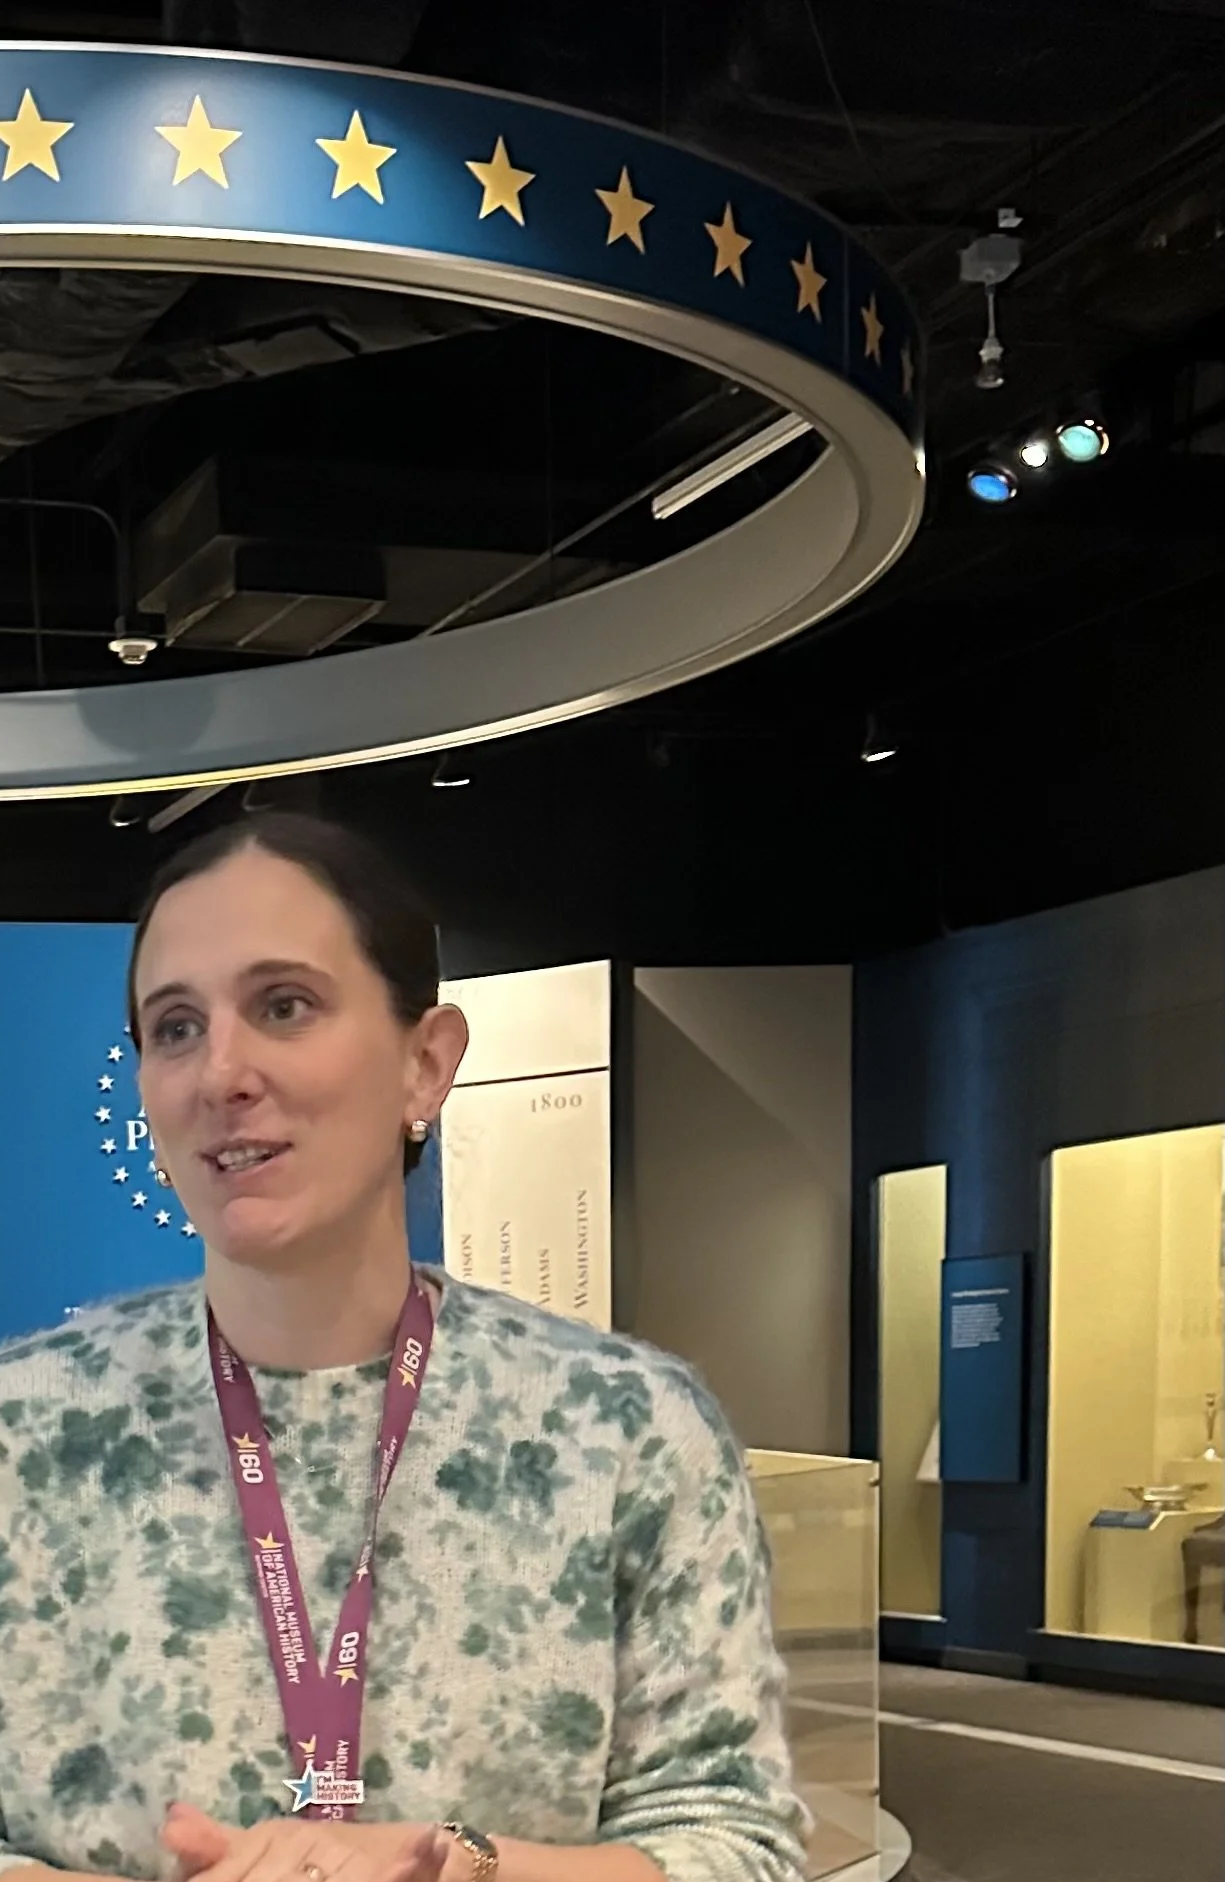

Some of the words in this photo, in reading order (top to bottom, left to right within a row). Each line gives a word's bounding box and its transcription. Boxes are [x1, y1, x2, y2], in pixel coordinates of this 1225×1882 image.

[531, 1093, 583, 1113] 1800
[573, 1189, 589, 1310] WASHINGTON
[403, 1337, 423, 1370] 60
[239, 1453, 264, 1484] 60
[261, 1554, 275, 1570] OF
[265, 1571, 286, 1632] AMERICAN
[273, 1553, 294, 1611] NATIONAL
[285, 1611, 307, 1663] MUSEUM
[278, 1633, 301, 1685] HISTORY
[338, 1631, 360, 1663] 60
[317, 1784, 357, 1792] MAKING
[317, 1792, 361, 1800] HISTORY
